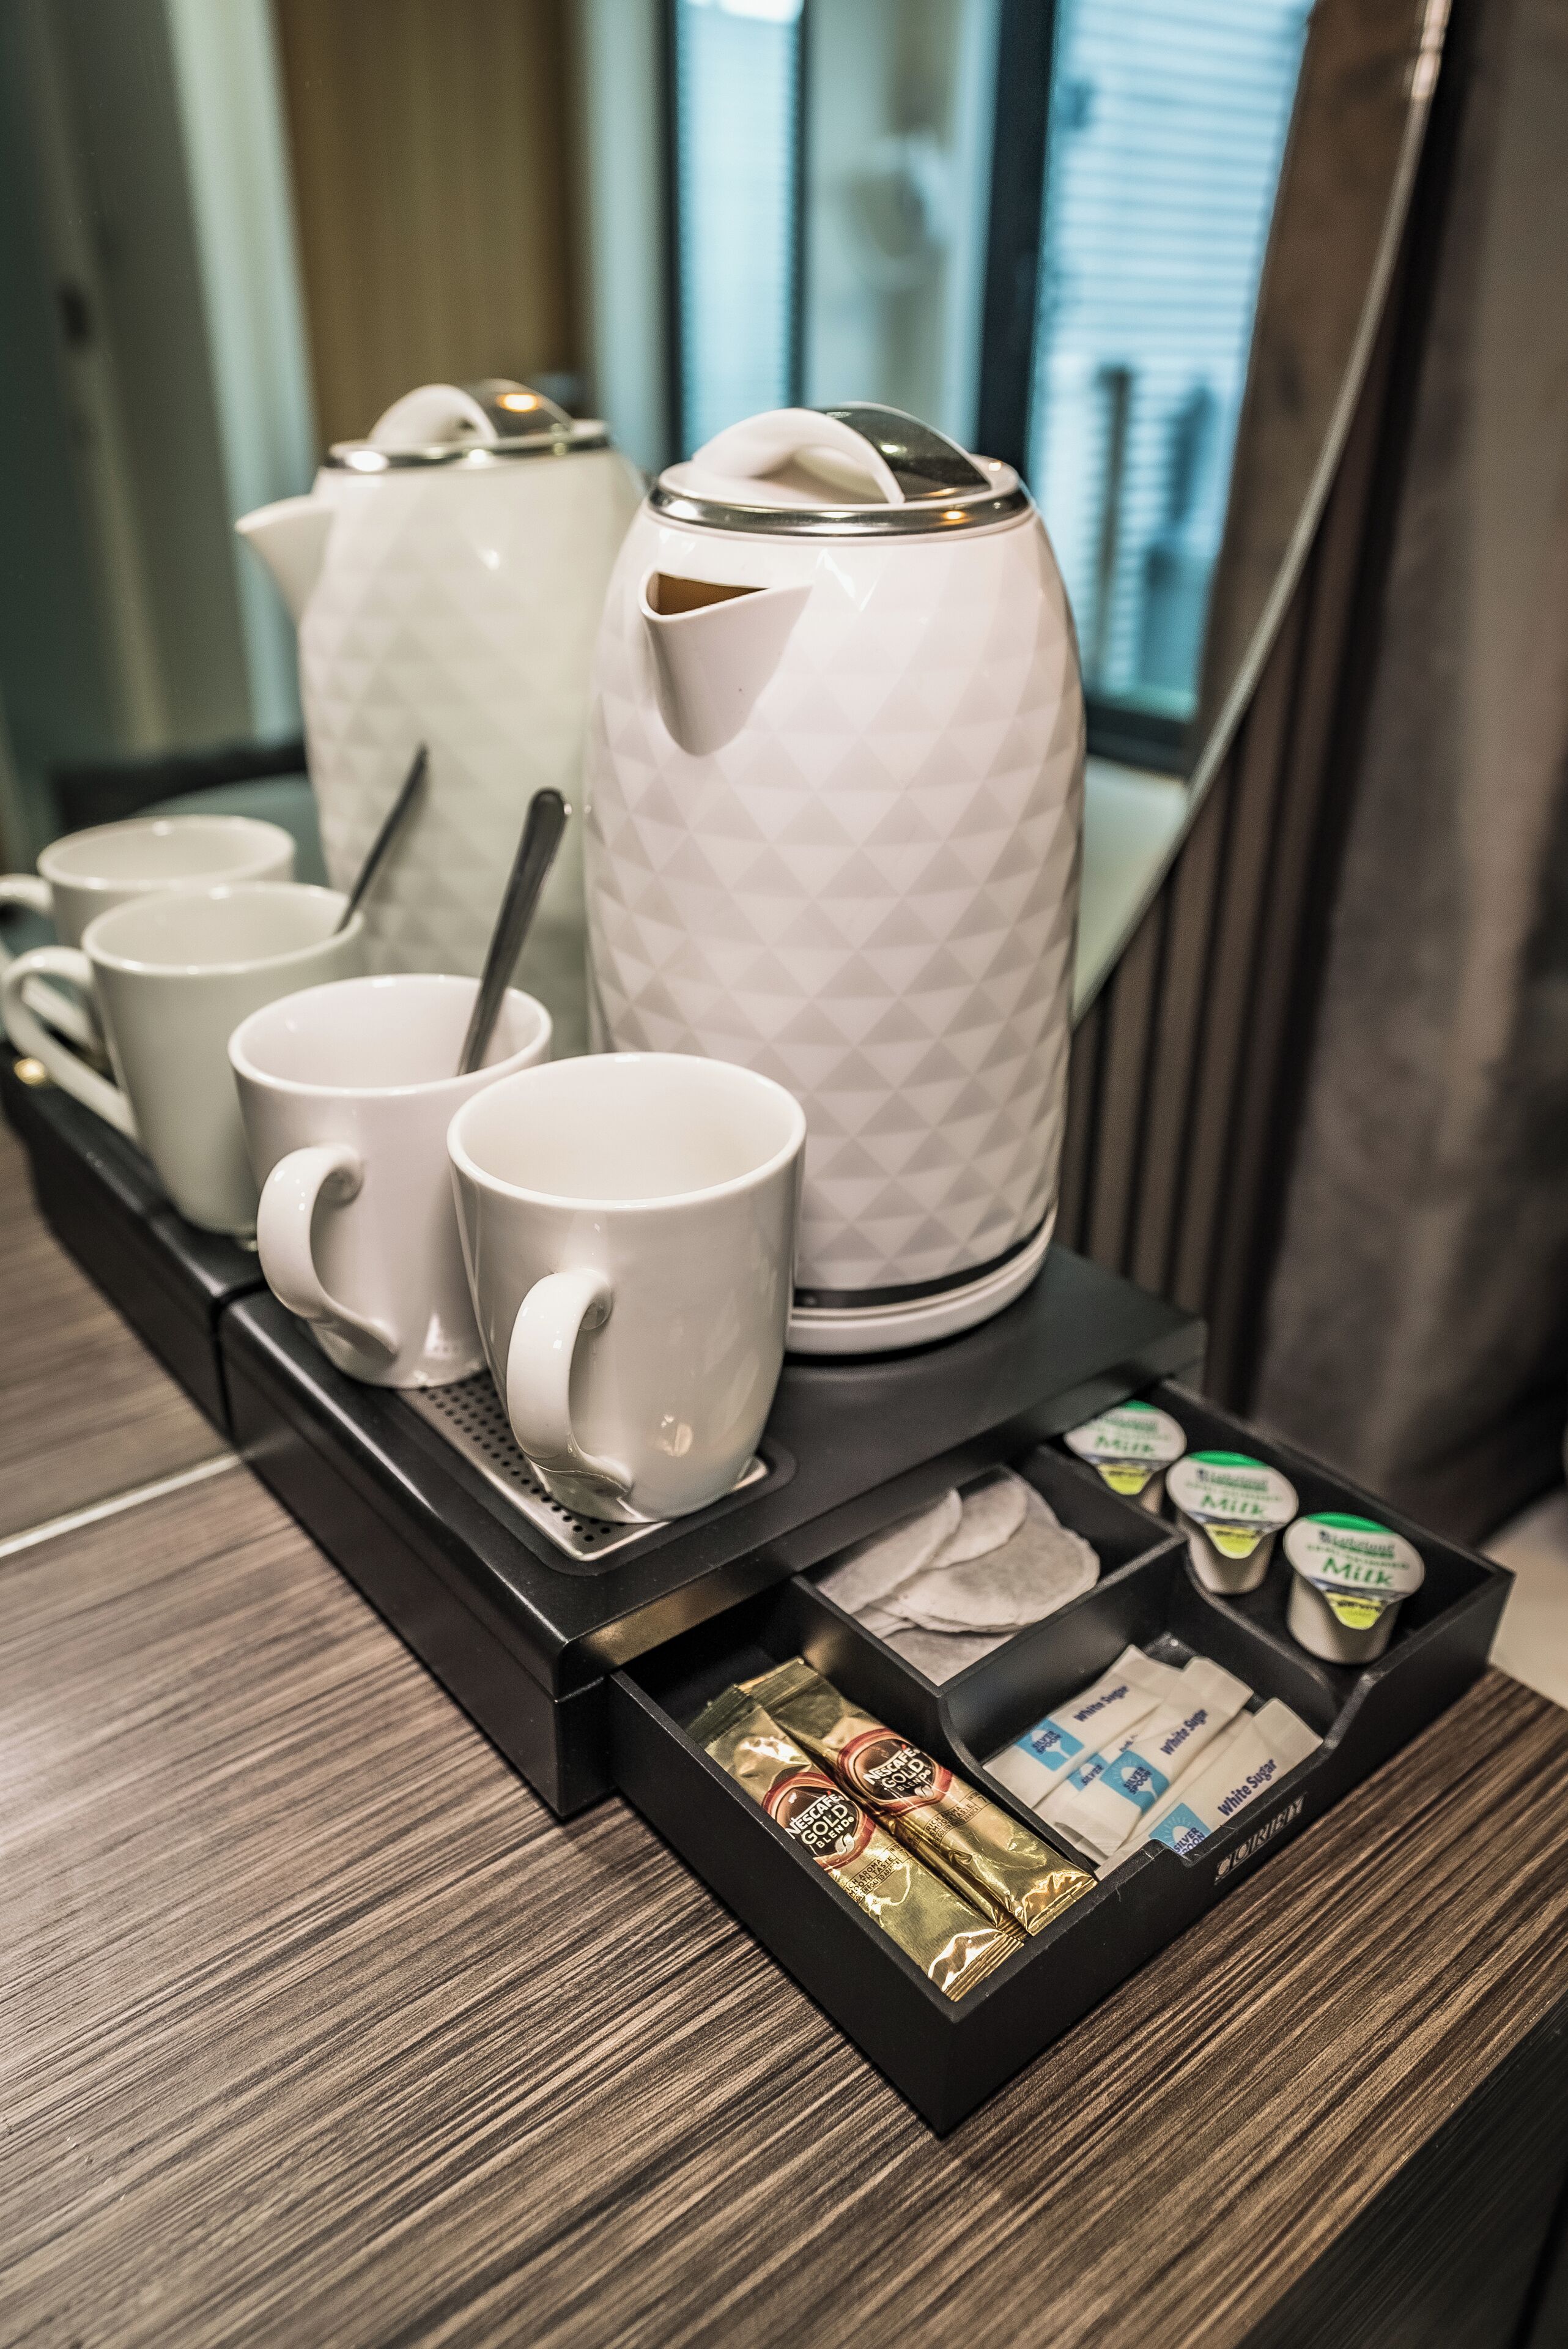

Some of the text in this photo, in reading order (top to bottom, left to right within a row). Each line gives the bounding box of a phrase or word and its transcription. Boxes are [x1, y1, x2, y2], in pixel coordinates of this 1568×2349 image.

[1200, 1494, 1263, 1517] Milk
[1322, 1557, 1393, 1586] Milk
[1073, 1685, 1128, 1721] White Sugar
[1032, 1731, 1057, 1748] SILVER
[1036, 1734, 1062, 1754] SPOON
[1160, 1709, 1208, 1755] White Sugar
[881, 1759, 924, 1788] GOLD
[1081, 1765, 1104, 1786] SILVER
[1123, 1767, 1146, 1788] SILVER
[1131, 1770, 1152, 1795] SPOON
[1218, 1759, 1277, 1816] White Sugar
[801, 1805, 848, 1844] GOLD
[925, 1816, 941, 1831] RICH
[929, 1816, 953, 1836] SMOOTH
[955, 1803, 972, 1819] TASTE
[938, 1824, 952, 1838] GOLDEN
[1174, 1827, 1200, 1852] SILVER
[846, 1859, 882, 1891] ICH AROMA
[848, 1856, 893, 1898] MOOTH TASTE
[868, 1874, 885, 1890] ROASTED
